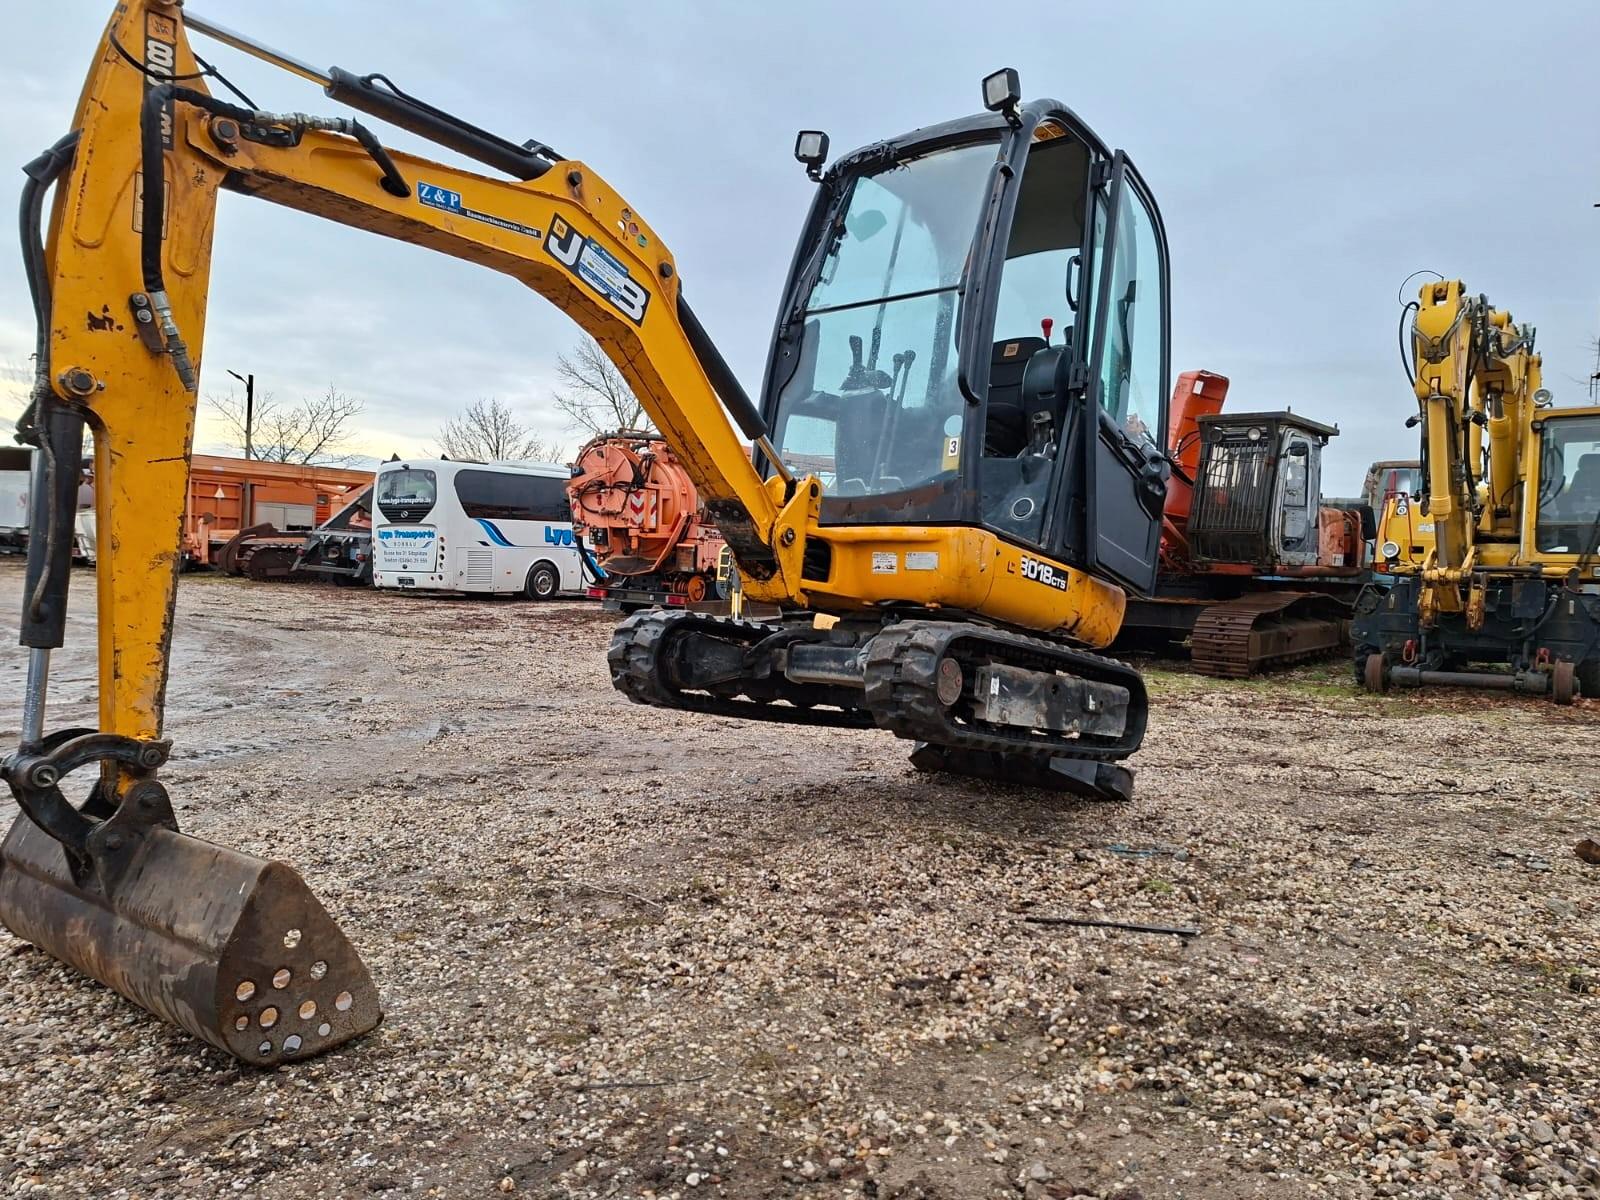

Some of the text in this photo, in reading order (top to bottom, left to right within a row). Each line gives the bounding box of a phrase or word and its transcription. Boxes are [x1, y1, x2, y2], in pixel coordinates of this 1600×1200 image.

[420, 184, 431, 199] Z
[434, 189, 446, 203] &
[449, 193, 459, 207] P
[950, 440, 957, 454] 3
